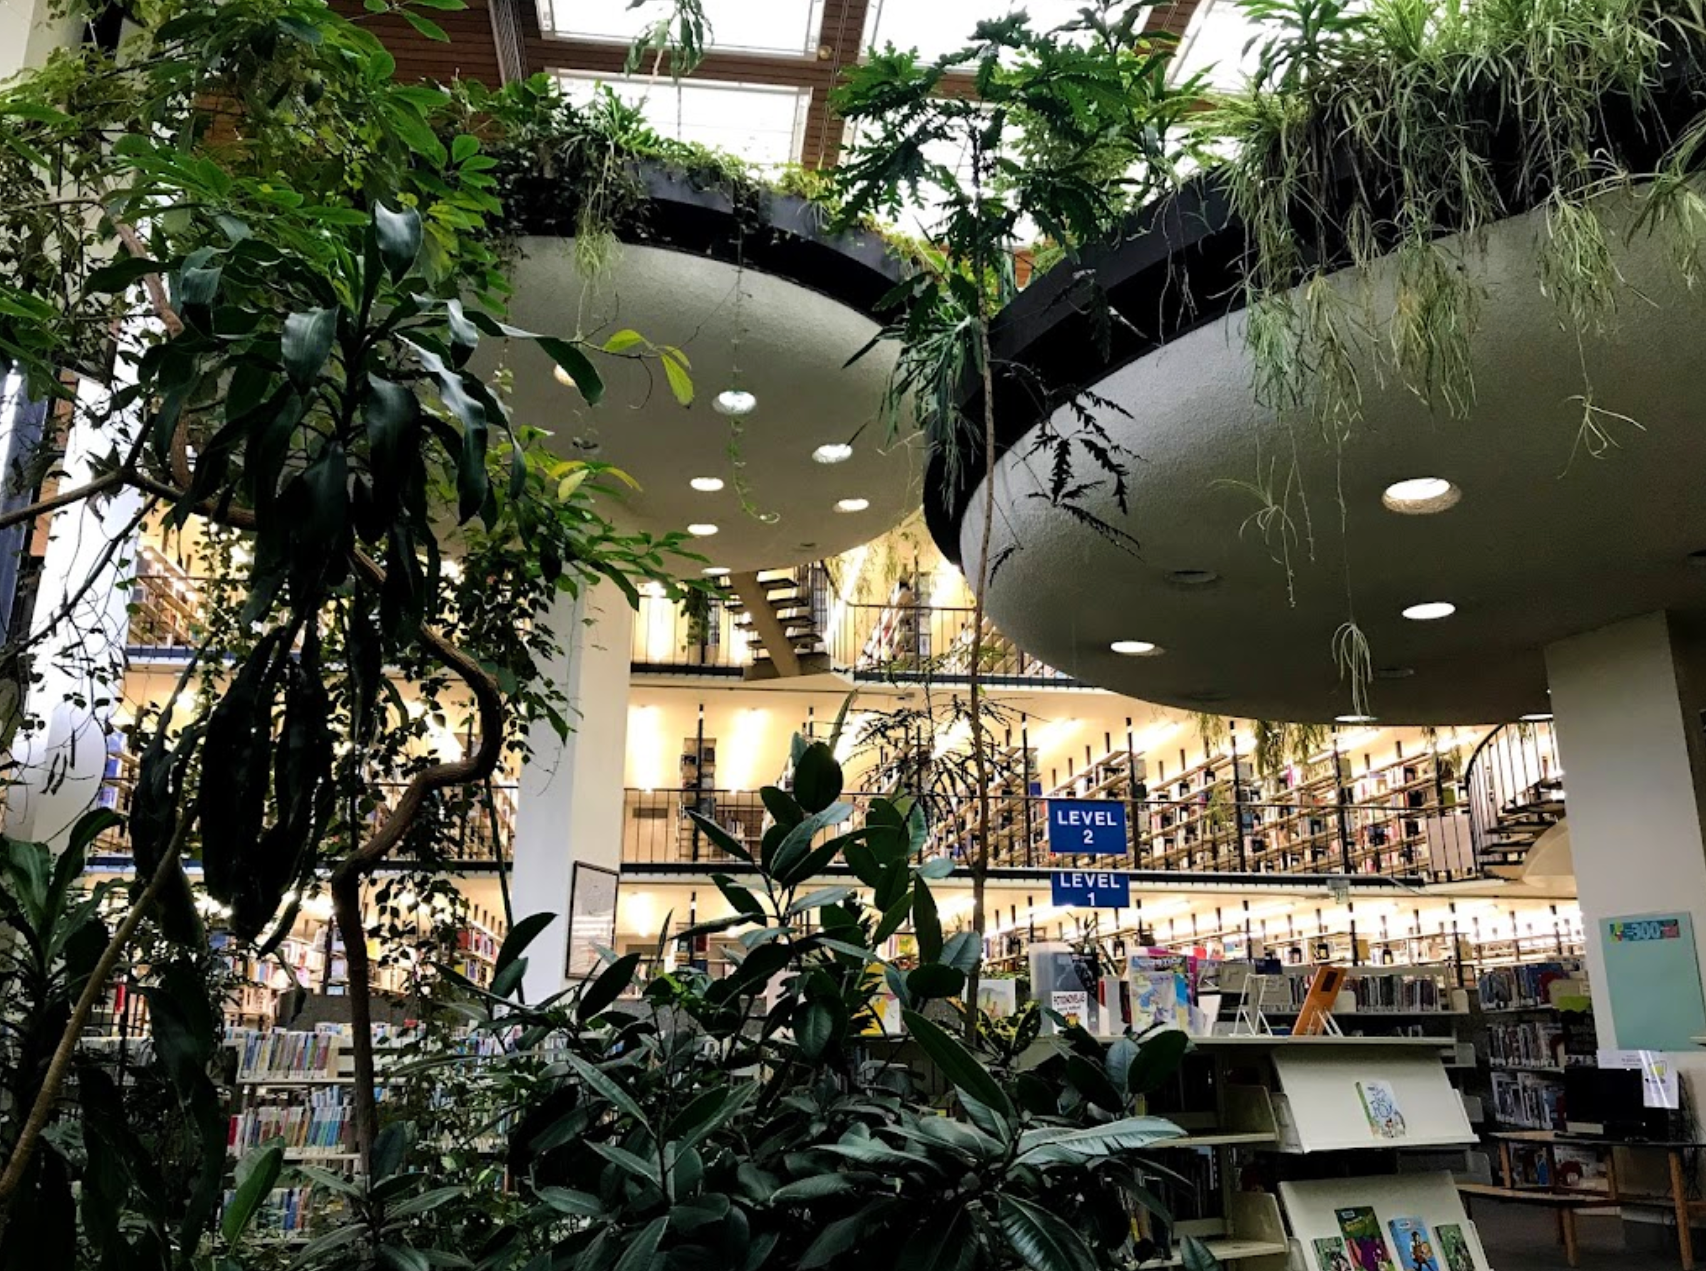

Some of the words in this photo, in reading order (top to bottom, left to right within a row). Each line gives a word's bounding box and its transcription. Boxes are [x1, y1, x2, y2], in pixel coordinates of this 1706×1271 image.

[1057, 810, 1117, 826] LEVEL
[1083, 829, 1094, 844] 2
[1060, 873, 1120, 888] LEVEL
[1087, 892, 1095, 906] 1
